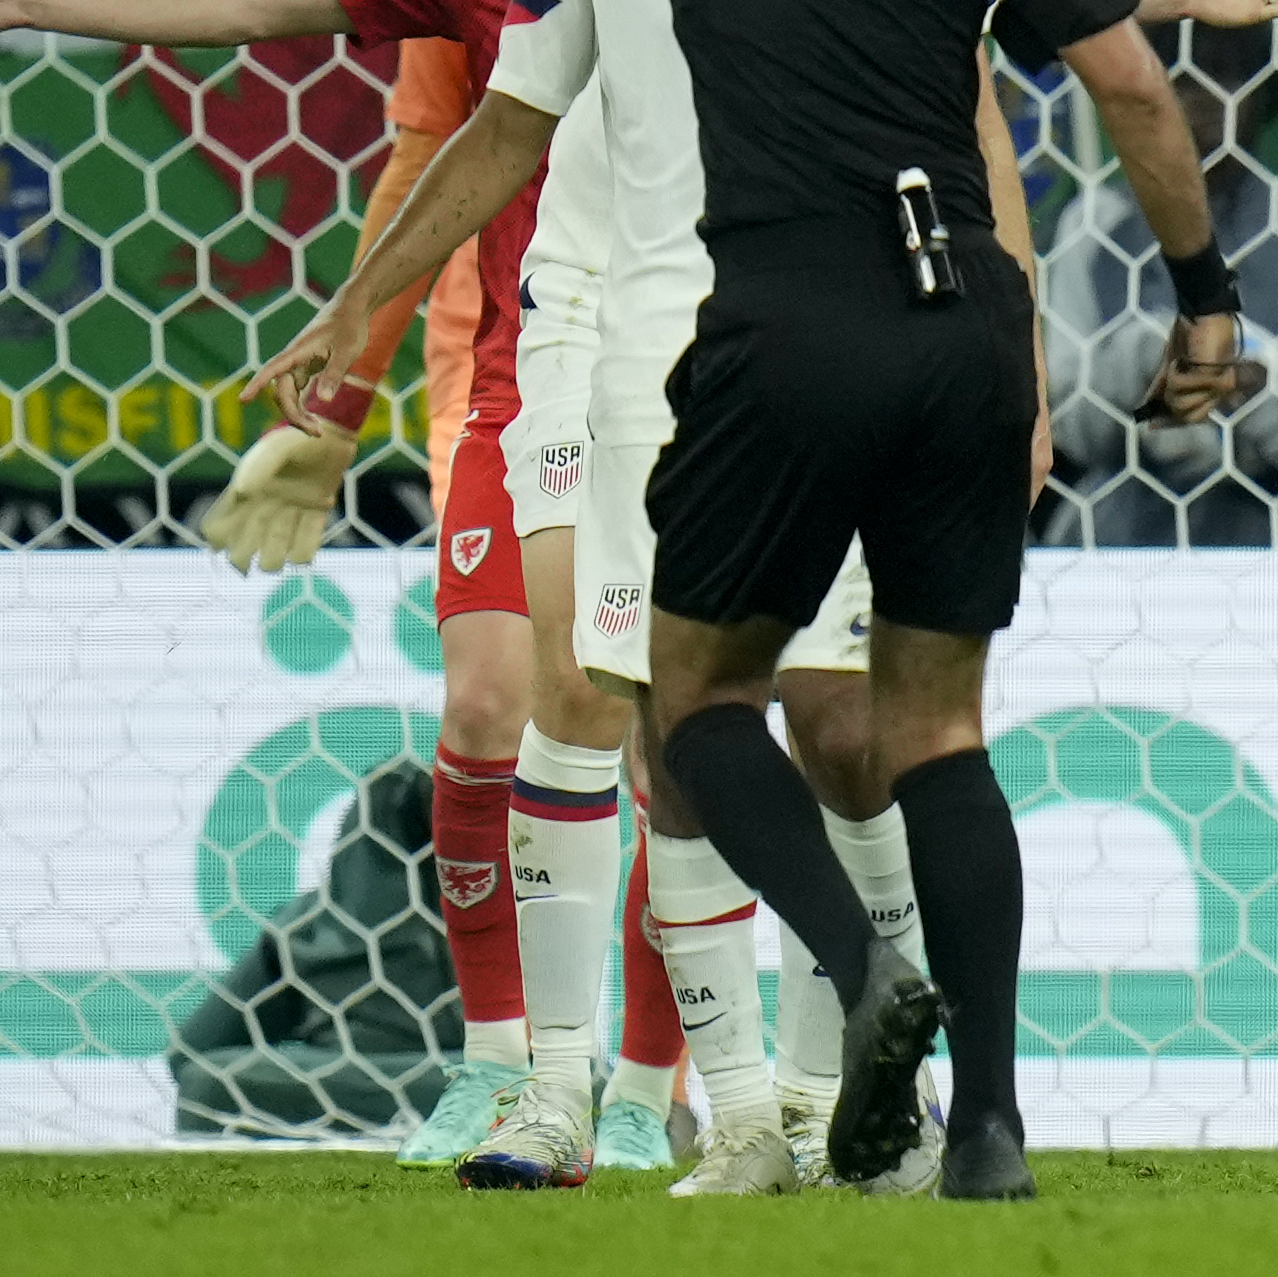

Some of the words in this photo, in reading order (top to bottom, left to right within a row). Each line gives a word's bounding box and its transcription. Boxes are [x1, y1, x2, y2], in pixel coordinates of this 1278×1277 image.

[545, 445, 581, 467] USA
[604, 587, 641, 610] USA
[515, 865, 551, 885] USA
[871, 901, 914, 922] USA
[676, 986, 716, 1004] USA
